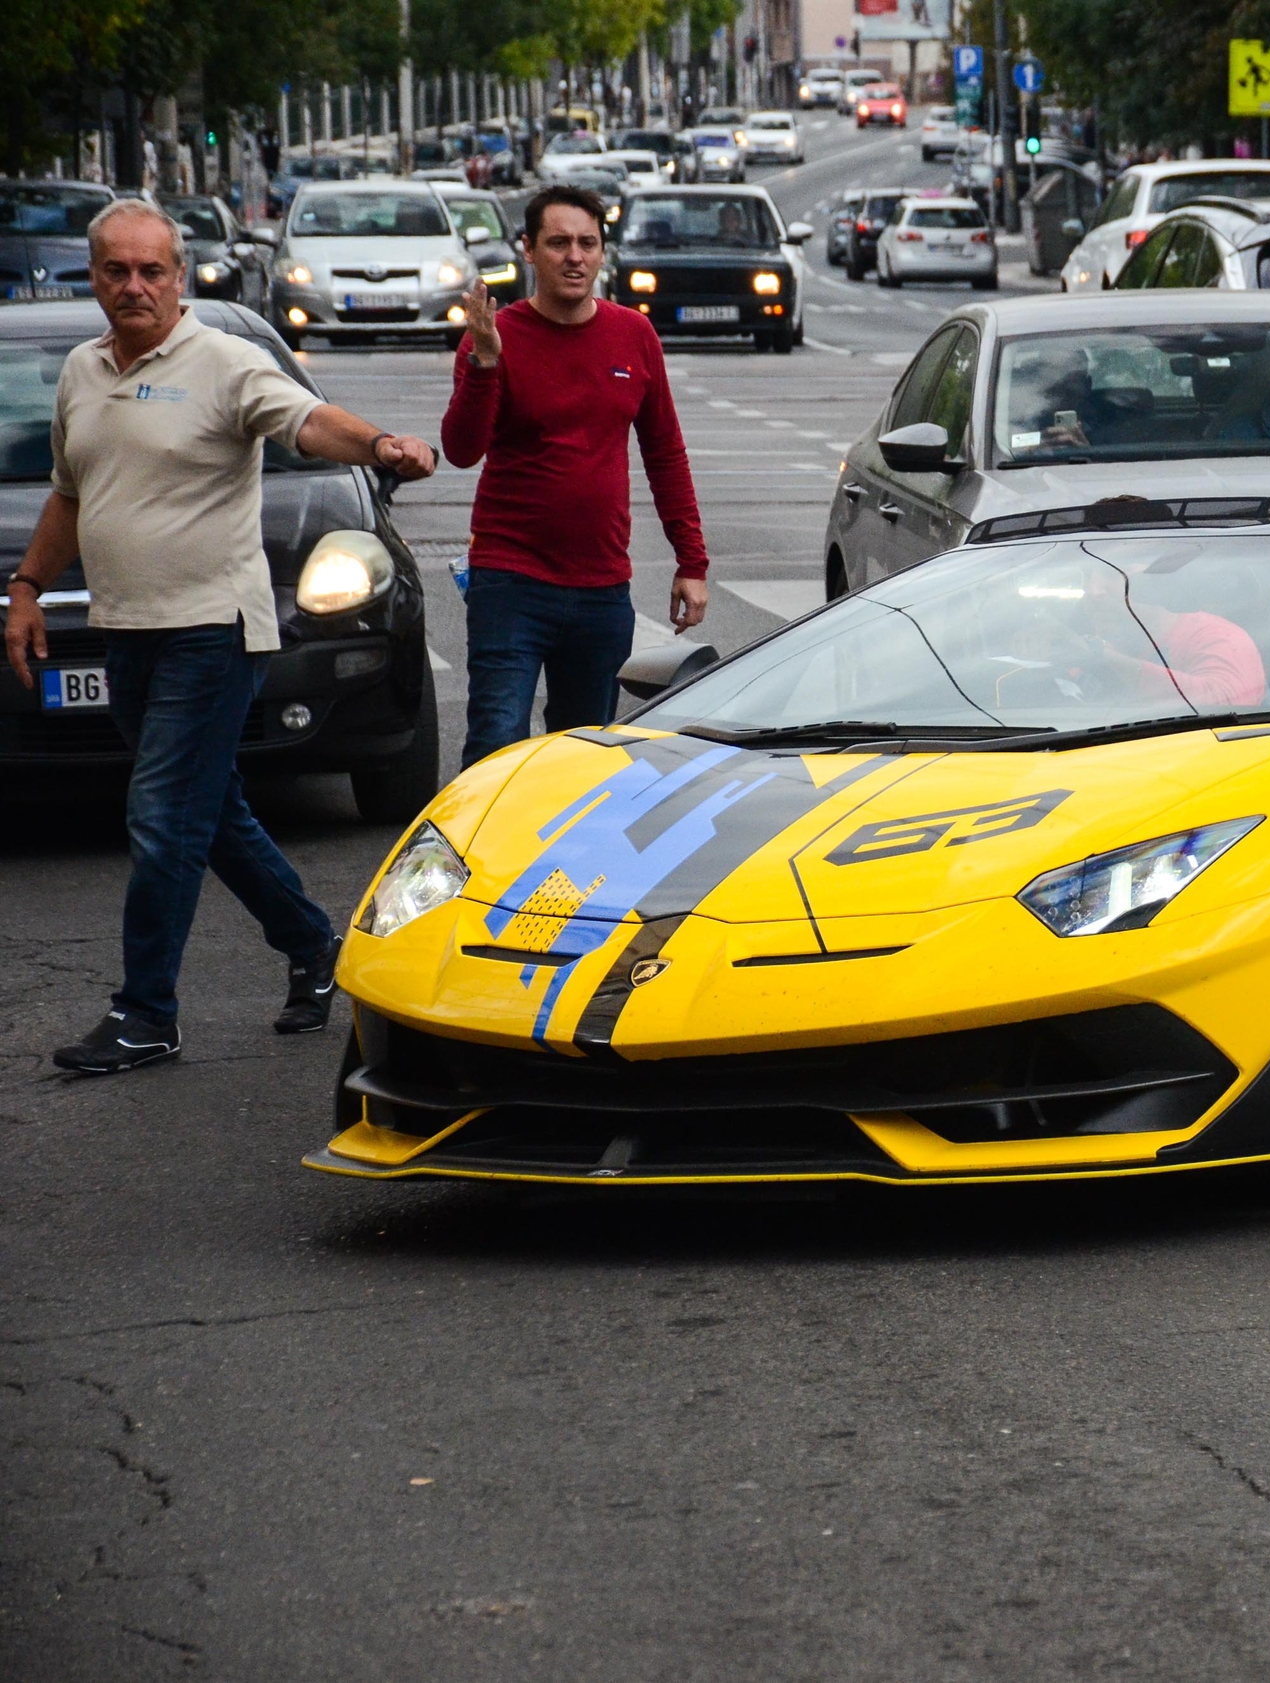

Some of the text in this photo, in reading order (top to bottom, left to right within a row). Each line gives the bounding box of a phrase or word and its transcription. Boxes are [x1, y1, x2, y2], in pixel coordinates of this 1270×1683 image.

[959, 48, 977, 74] P
[66, 672, 100, 702] BG
[822, 788, 1076, 866] 63
